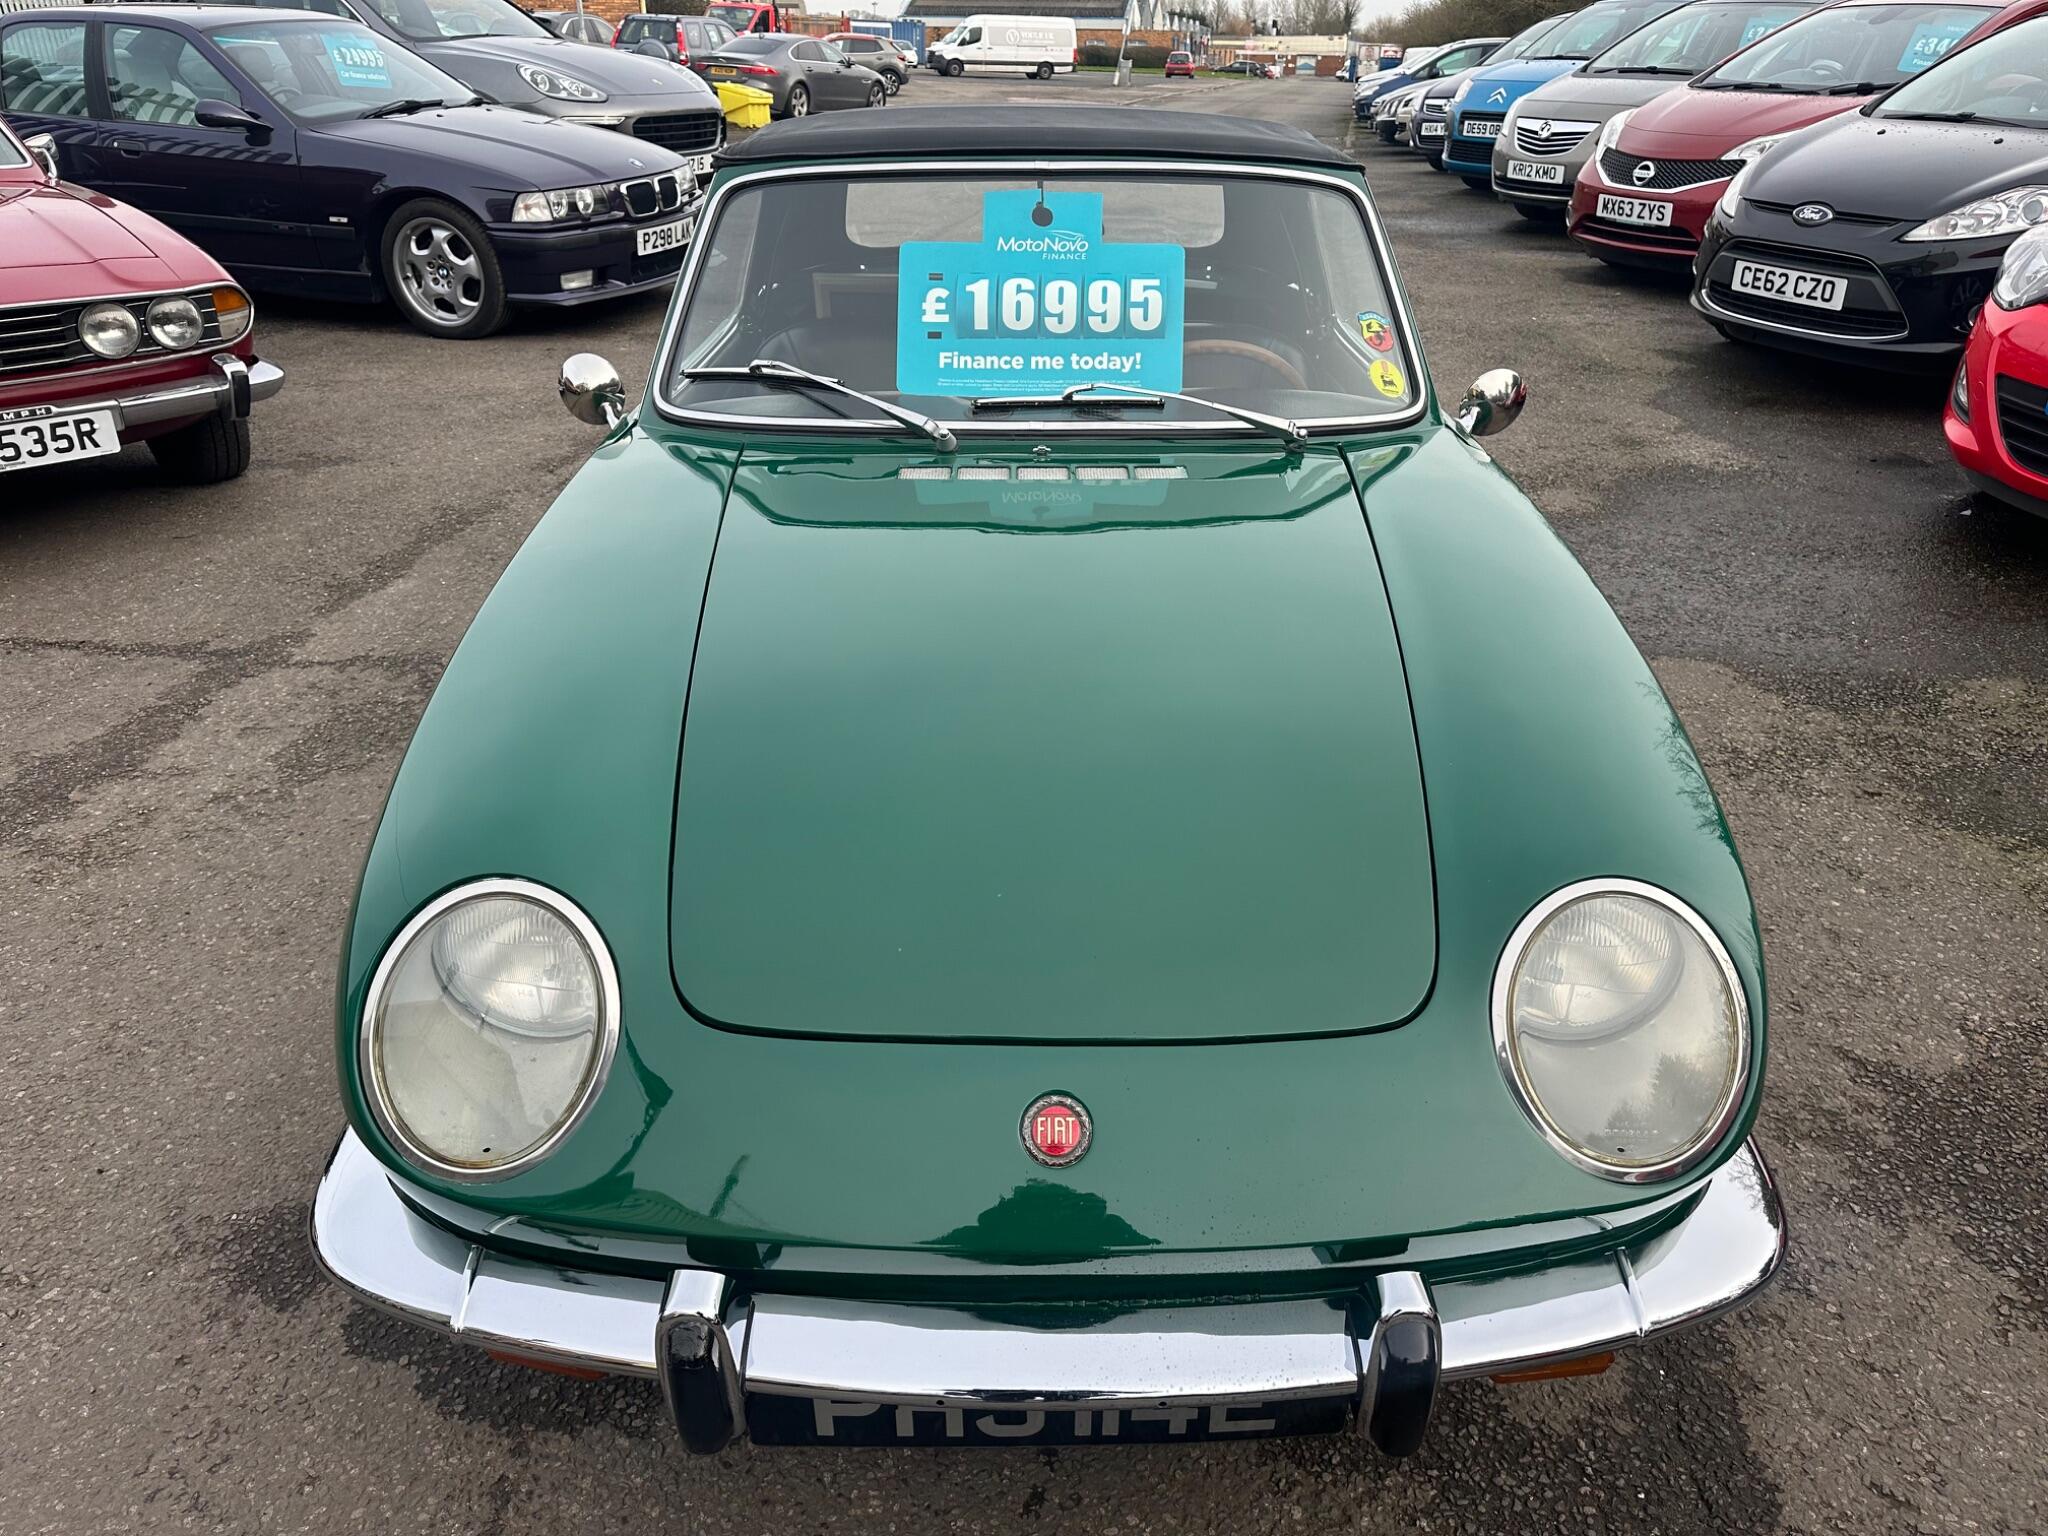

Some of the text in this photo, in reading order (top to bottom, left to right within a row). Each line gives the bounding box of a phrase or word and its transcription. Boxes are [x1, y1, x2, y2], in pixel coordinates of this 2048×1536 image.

[1466, 122, 1488, 135] DE59
[1513, 163, 1557, 181] KR12 KMO
[1601, 197, 1666, 222] MX63 ZYS
[1799, 206, 1823, 220] Ford
[643, 227, 673, 251] P298
[997, 235, 1088, 253] MotoNovo
[1042, 252, 1087, 260] FINANCE
[1740, 265, 1836, 303] CE62 CZO
[939, 351, 1141, 373] Finance me today!
[0, 417, 102, 462] 535R
[1037, 1116, 1076, 1145] FIAT
